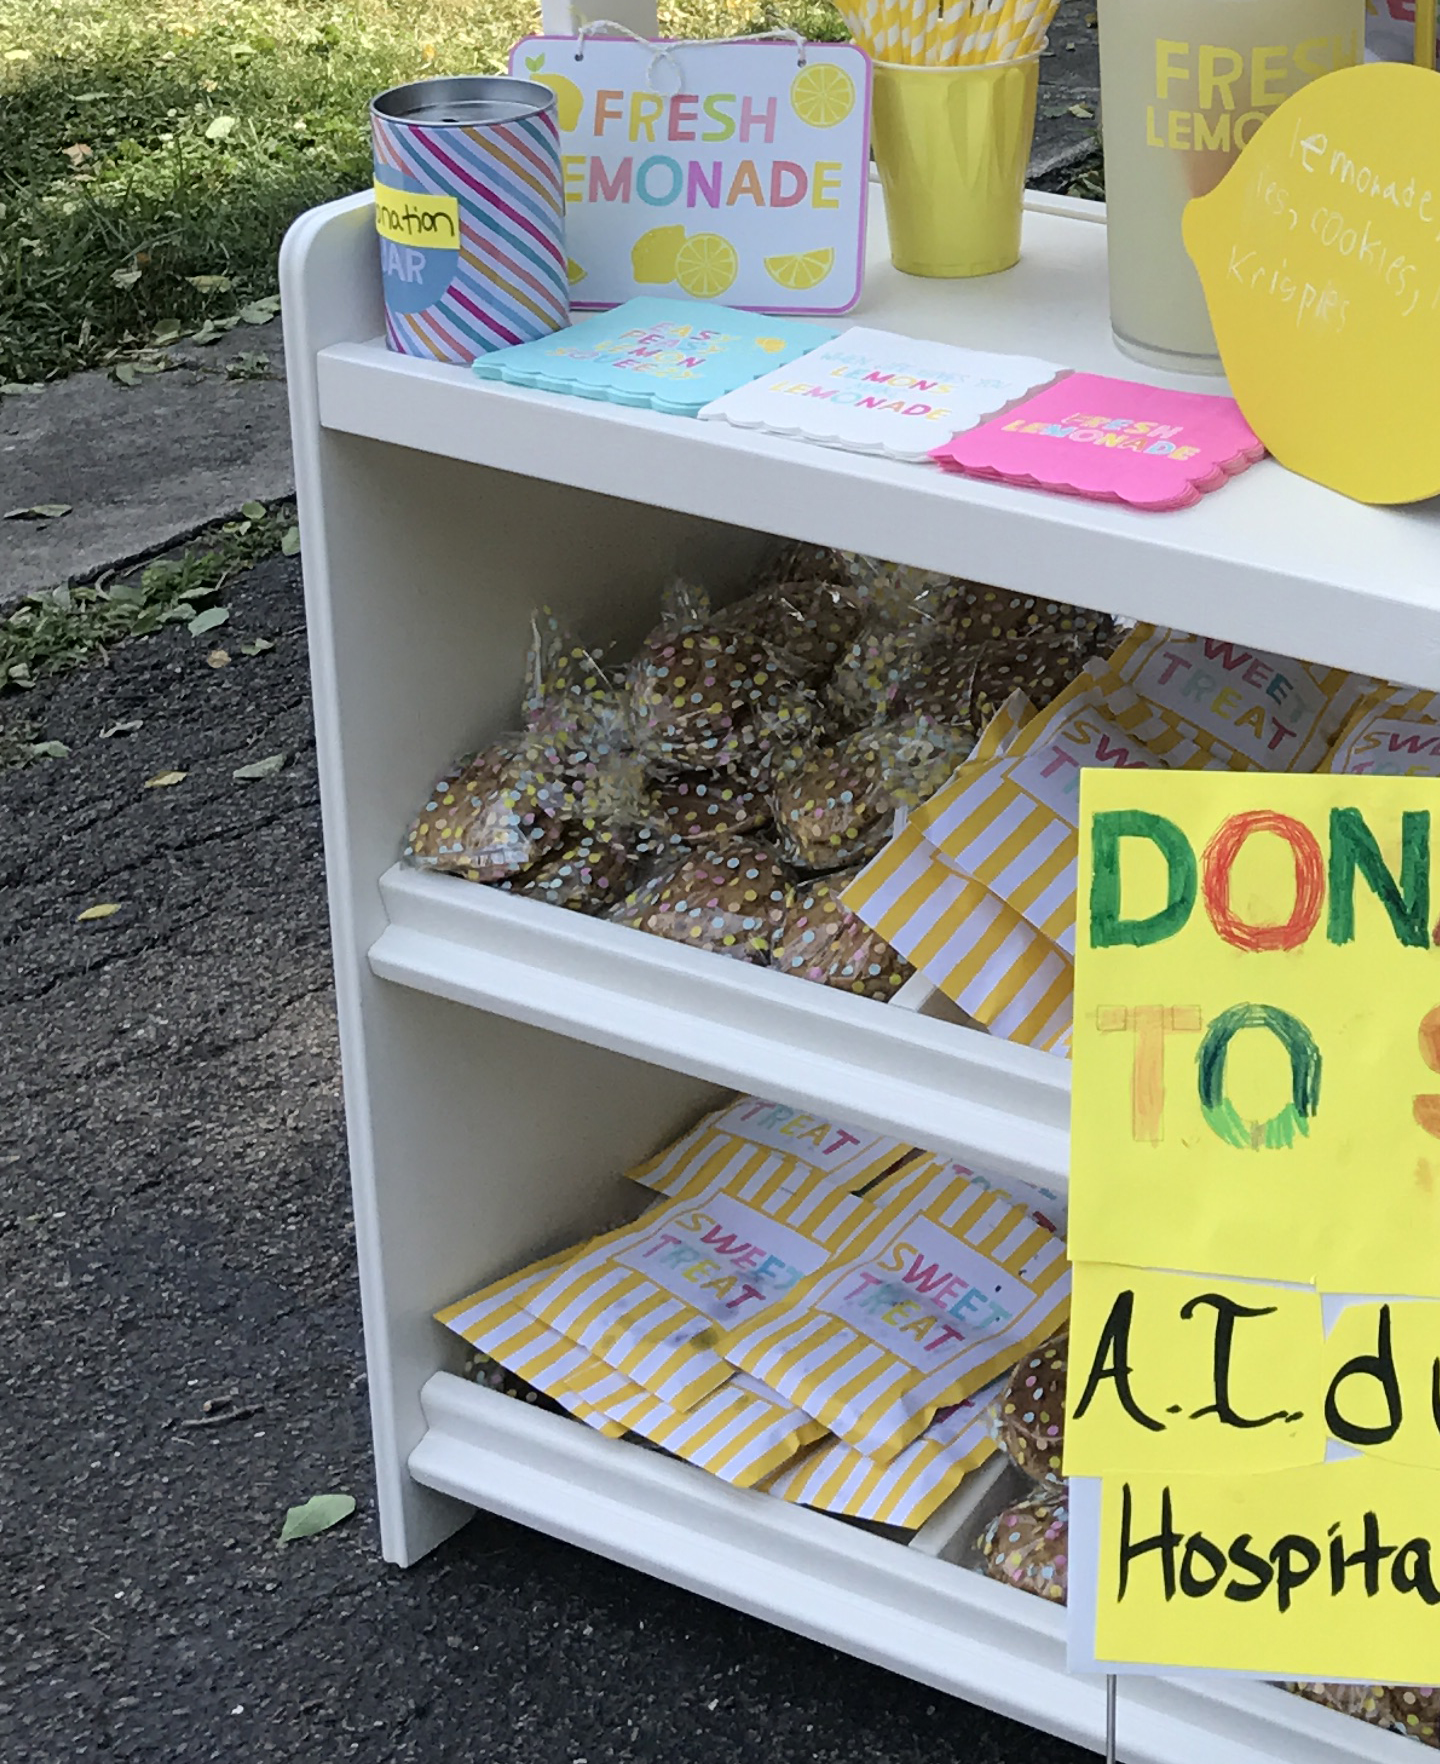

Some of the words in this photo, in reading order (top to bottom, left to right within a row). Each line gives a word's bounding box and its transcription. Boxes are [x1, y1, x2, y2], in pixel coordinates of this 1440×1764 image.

[593, 90, 777, 143] FRESH
[562, 154, 843, 209] EMONADE
[769, 380, 953, 420] LEMONADE
[829, 365, 954, 395] LEMONS
[1001, 419, 1201, 461] LEMONADE
[1060, 412, 1184, 439] FRESH
[1157, 651, 1297, 752] TREAT
[1170, 627, 1310, 725] WEET
[1094, 1001, 1323, 1153] TO
[740, 1100, 861, 1155] TREAT
[642, 1233, 767, 1309] TREAT
[676, 1212, 805, 1290] SWEET
[843, 1270, 966, 1353] TREAT
[878, 1240, 1014, 1329] SWEET
